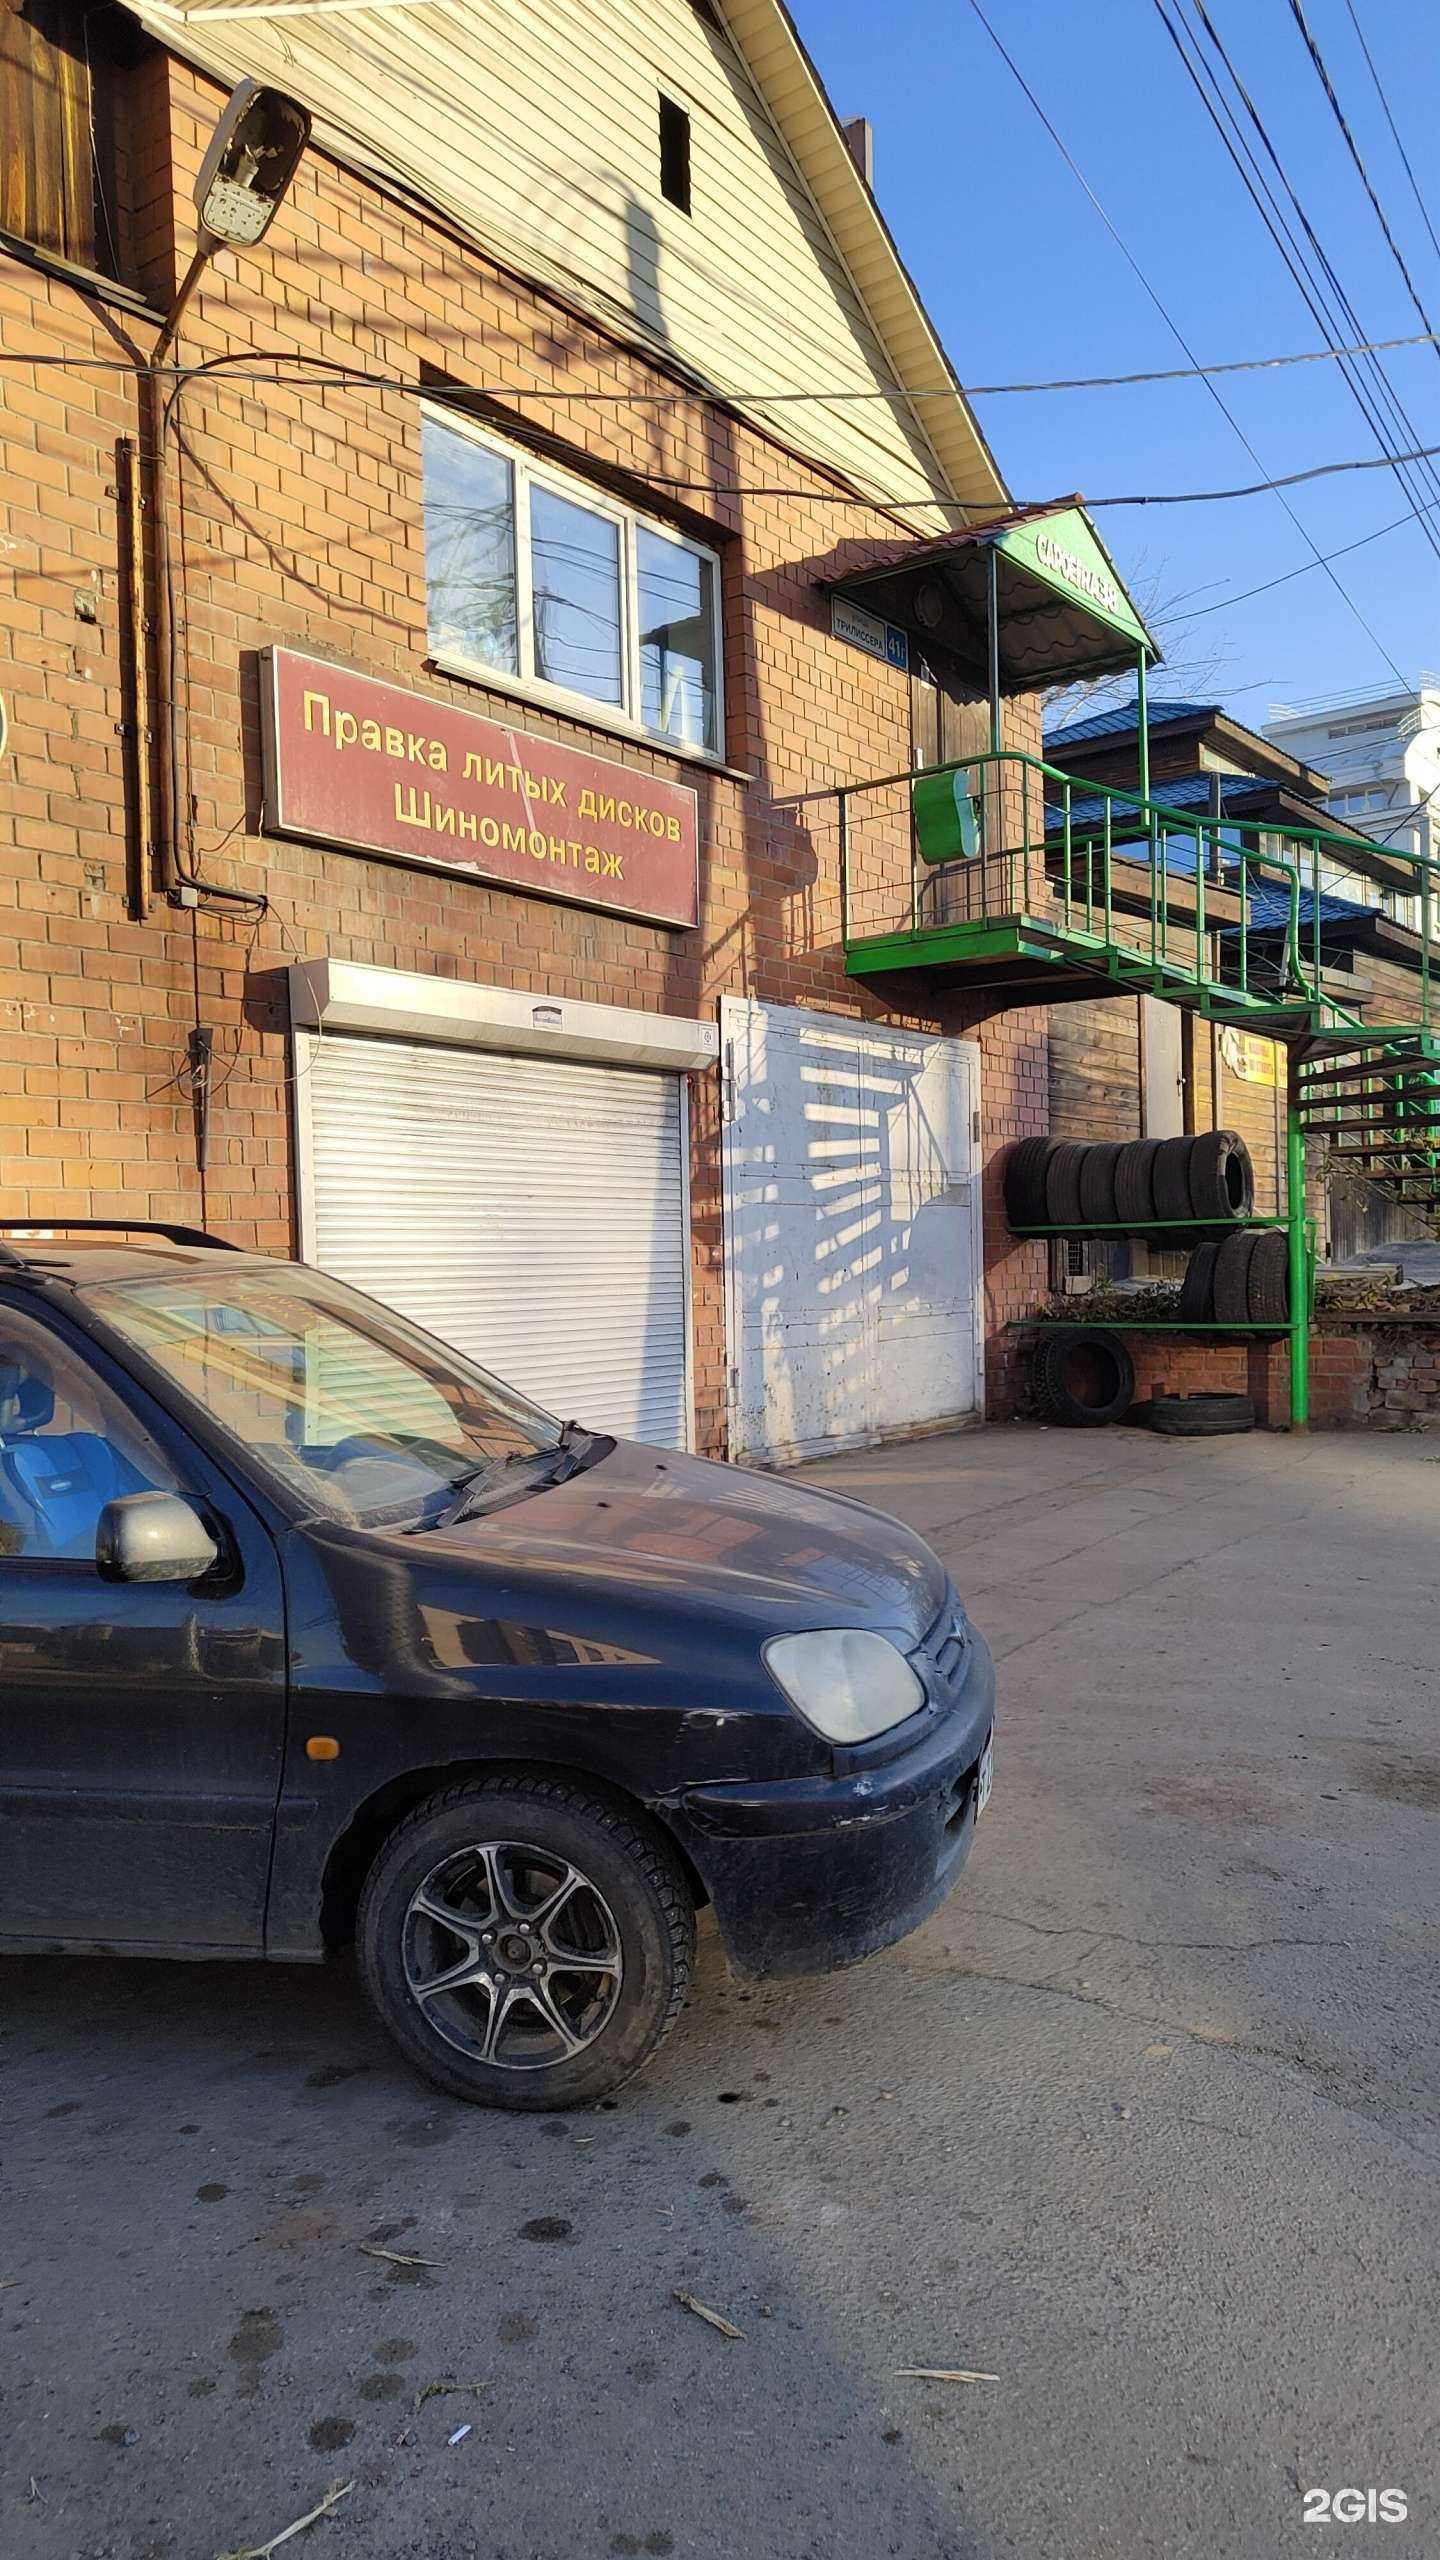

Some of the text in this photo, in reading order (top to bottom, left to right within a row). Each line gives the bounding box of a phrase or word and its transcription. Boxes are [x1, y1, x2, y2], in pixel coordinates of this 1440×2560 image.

[836, 617, 884, 649] ТРИЛИССЕРА
[303, 690, 682, 842] Правка литых дисков
[394, 783, 625, 880] Шиномонтаж
